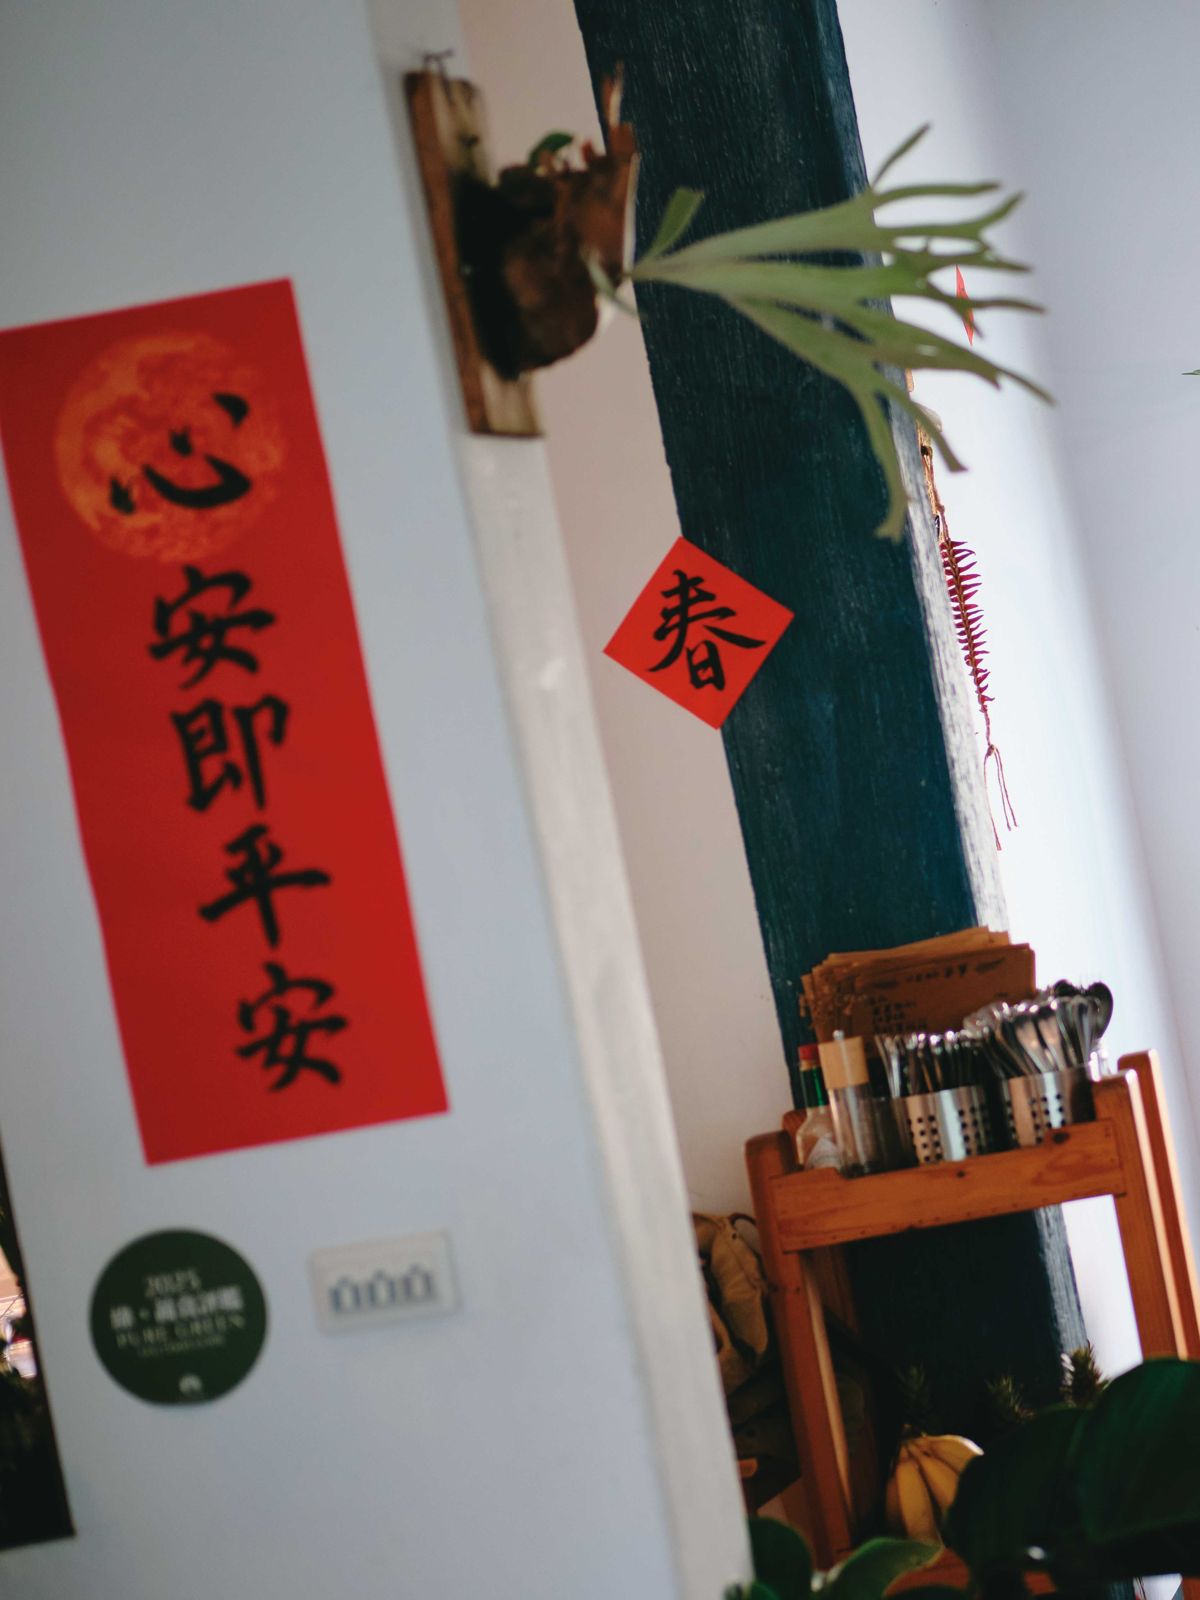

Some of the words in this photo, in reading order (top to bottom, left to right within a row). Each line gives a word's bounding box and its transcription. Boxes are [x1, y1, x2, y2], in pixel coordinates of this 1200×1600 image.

[109, 392, 350, 1093] 心安即平安
[646, 568, 767, 691] 春
